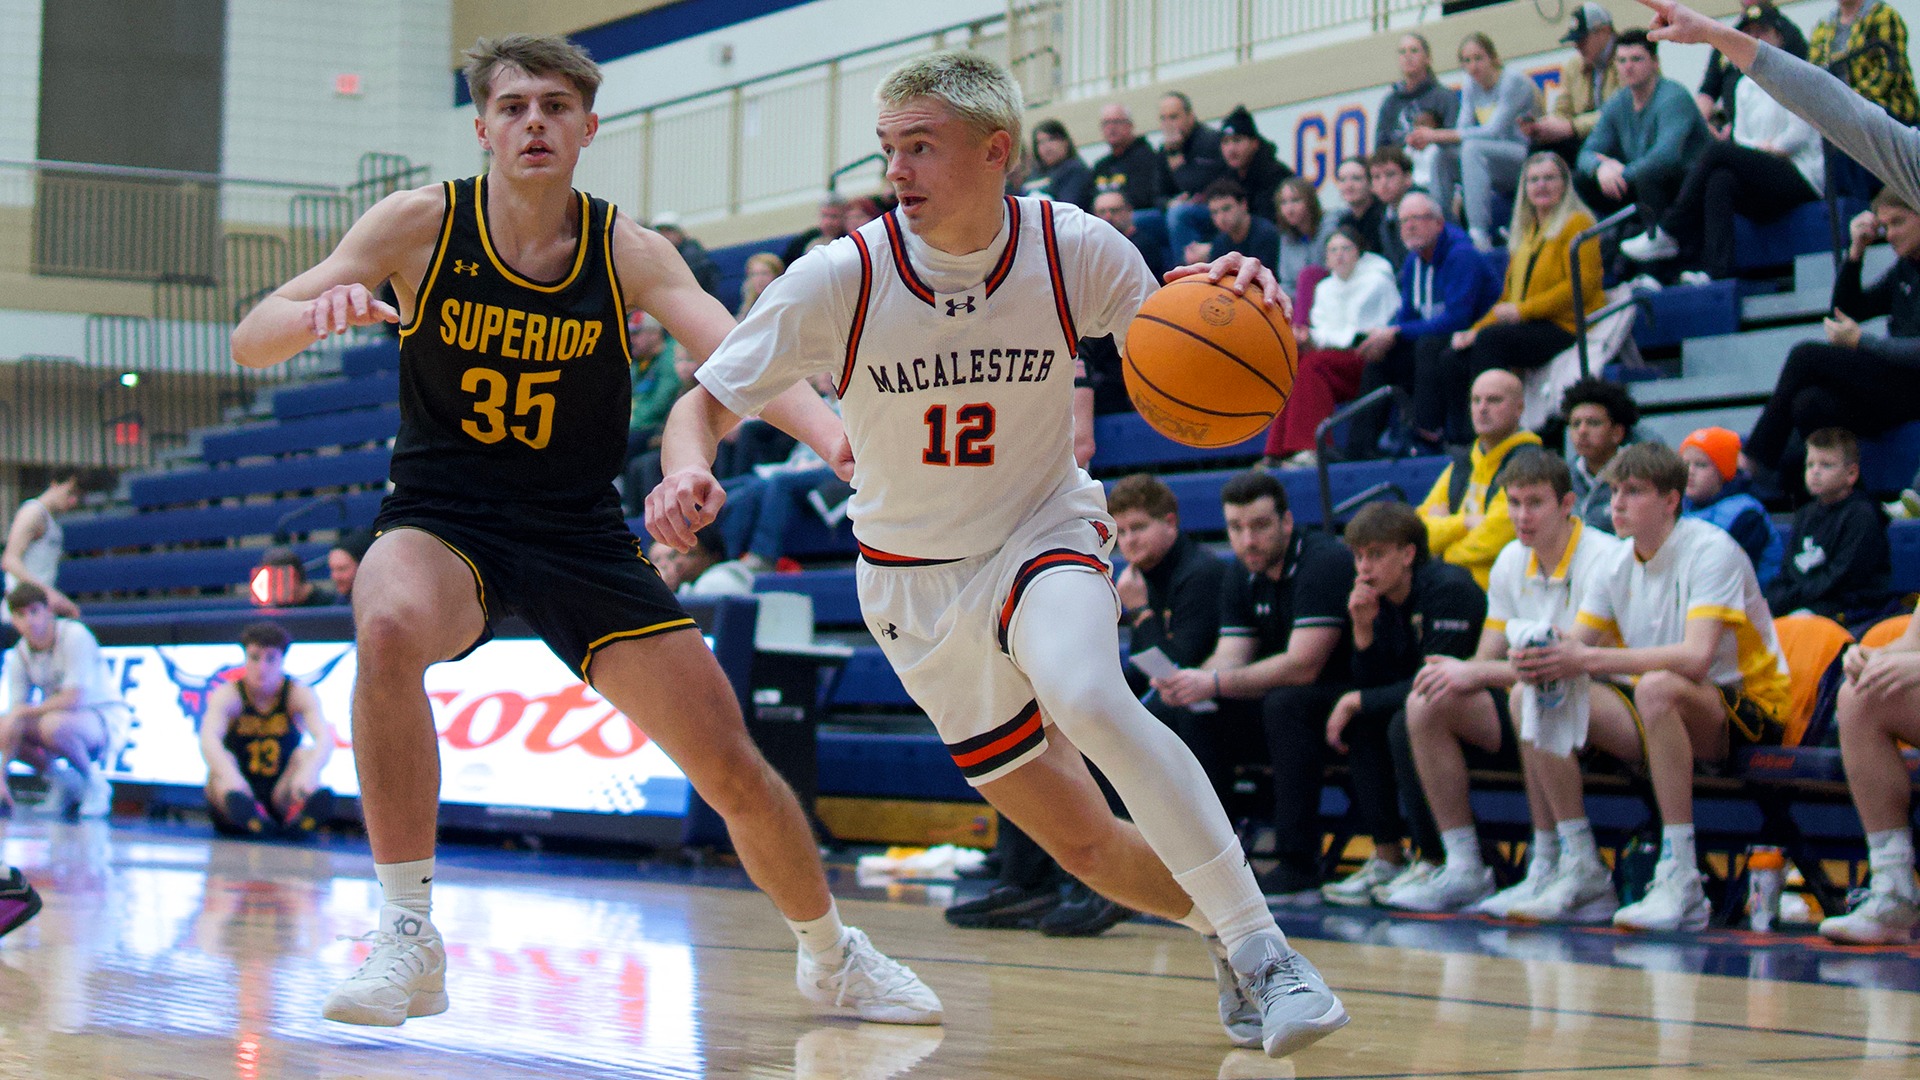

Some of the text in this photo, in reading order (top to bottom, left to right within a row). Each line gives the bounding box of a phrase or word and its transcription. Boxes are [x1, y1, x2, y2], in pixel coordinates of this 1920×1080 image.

[439, 298, 603, 362] SUPERIOR
[867, 349, 1055, 394] MACALESTER
[460, 366, 562, 450] 35
[922, 402, 996, 467] 12
[246, 738, 280, 775] 13
